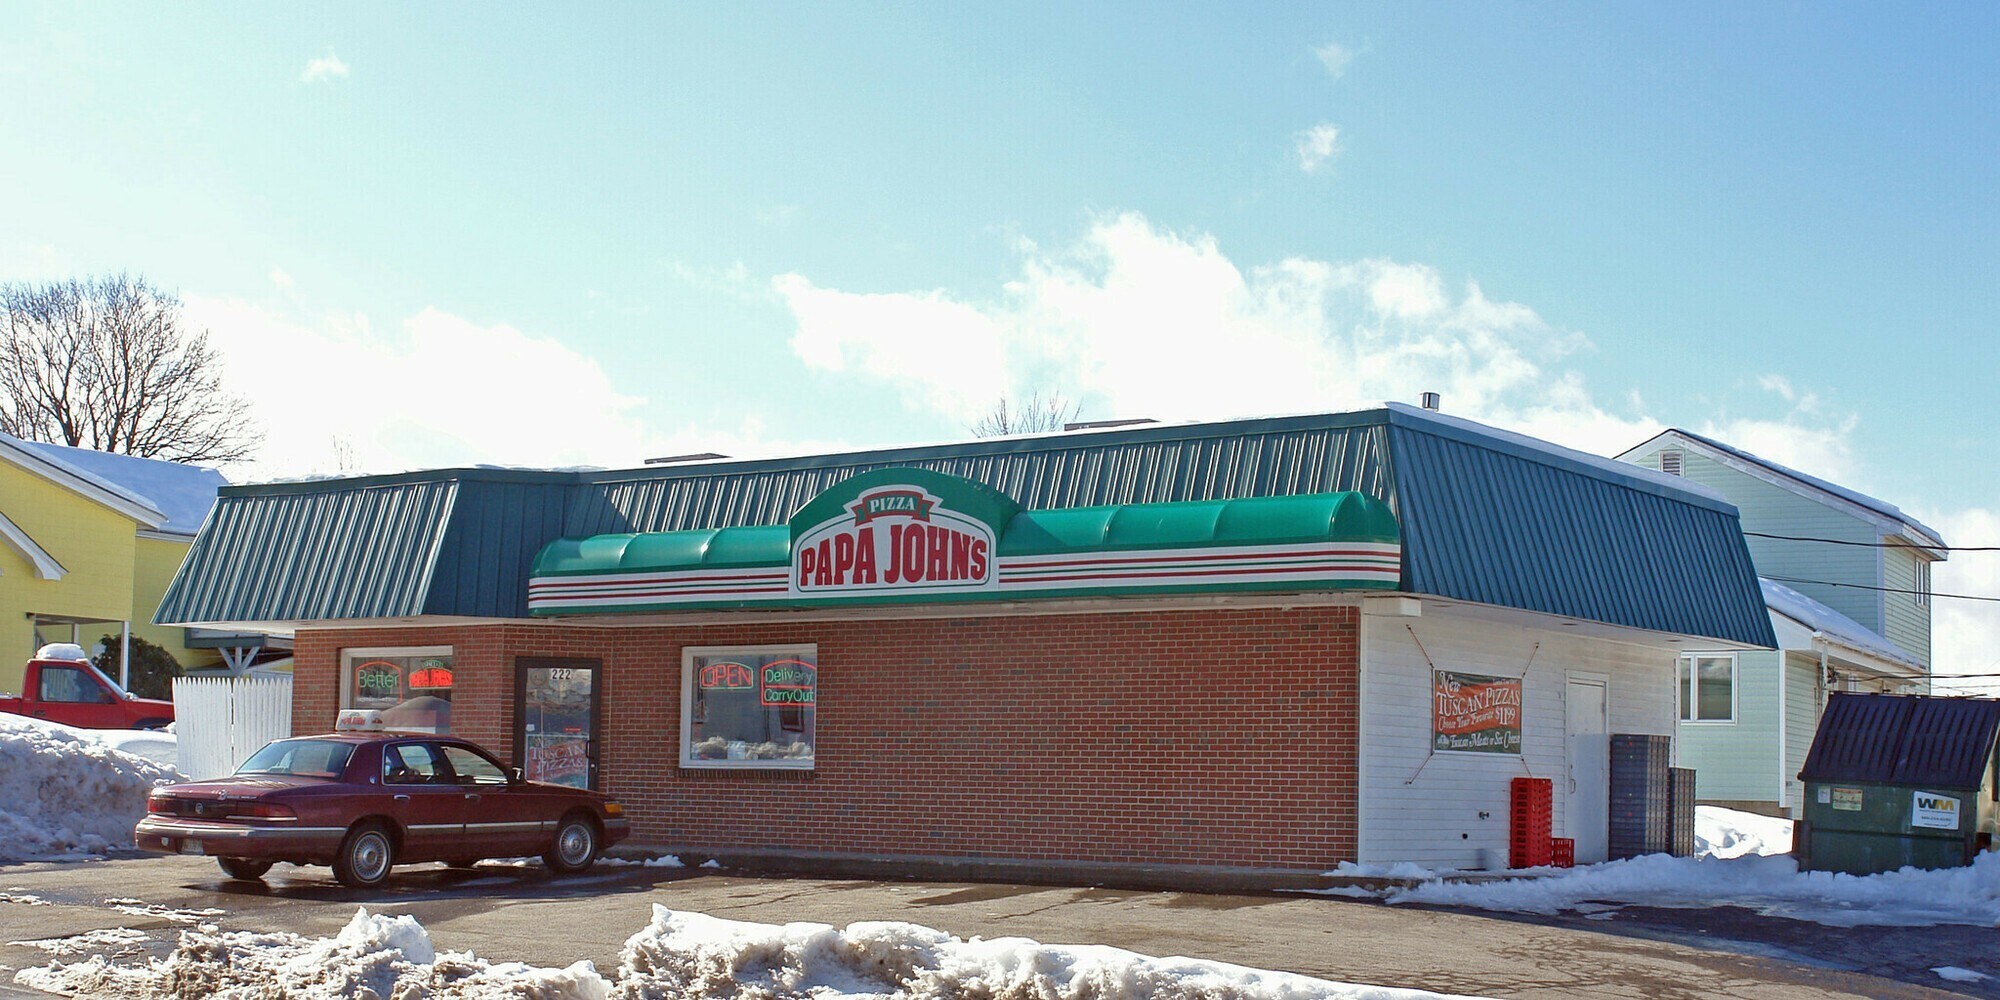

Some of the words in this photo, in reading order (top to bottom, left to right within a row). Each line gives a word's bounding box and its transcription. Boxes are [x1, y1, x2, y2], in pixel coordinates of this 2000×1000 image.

[870, 497, 915, 513] PIZZA
[800, 527, 877, 587] PAPA
[884, 523, 987, 584] JOHN'S
[357, 669, 399, 688] Better
[551, 669, 572, 680] 222
[701, 664, 752, 687] OPEN
[765, 668, 813, 685] Delivery
[1439, 671, 1461, 698] New
[1436, 692, 1484, 717] TUSCAN
[1485, 687, 1520, 708] PIZZAS
[530, 744, 586, 761] TUSCAN
[536, 757, 583, 774] PIZZAS
[1917, 797, 1954, 811] WM
